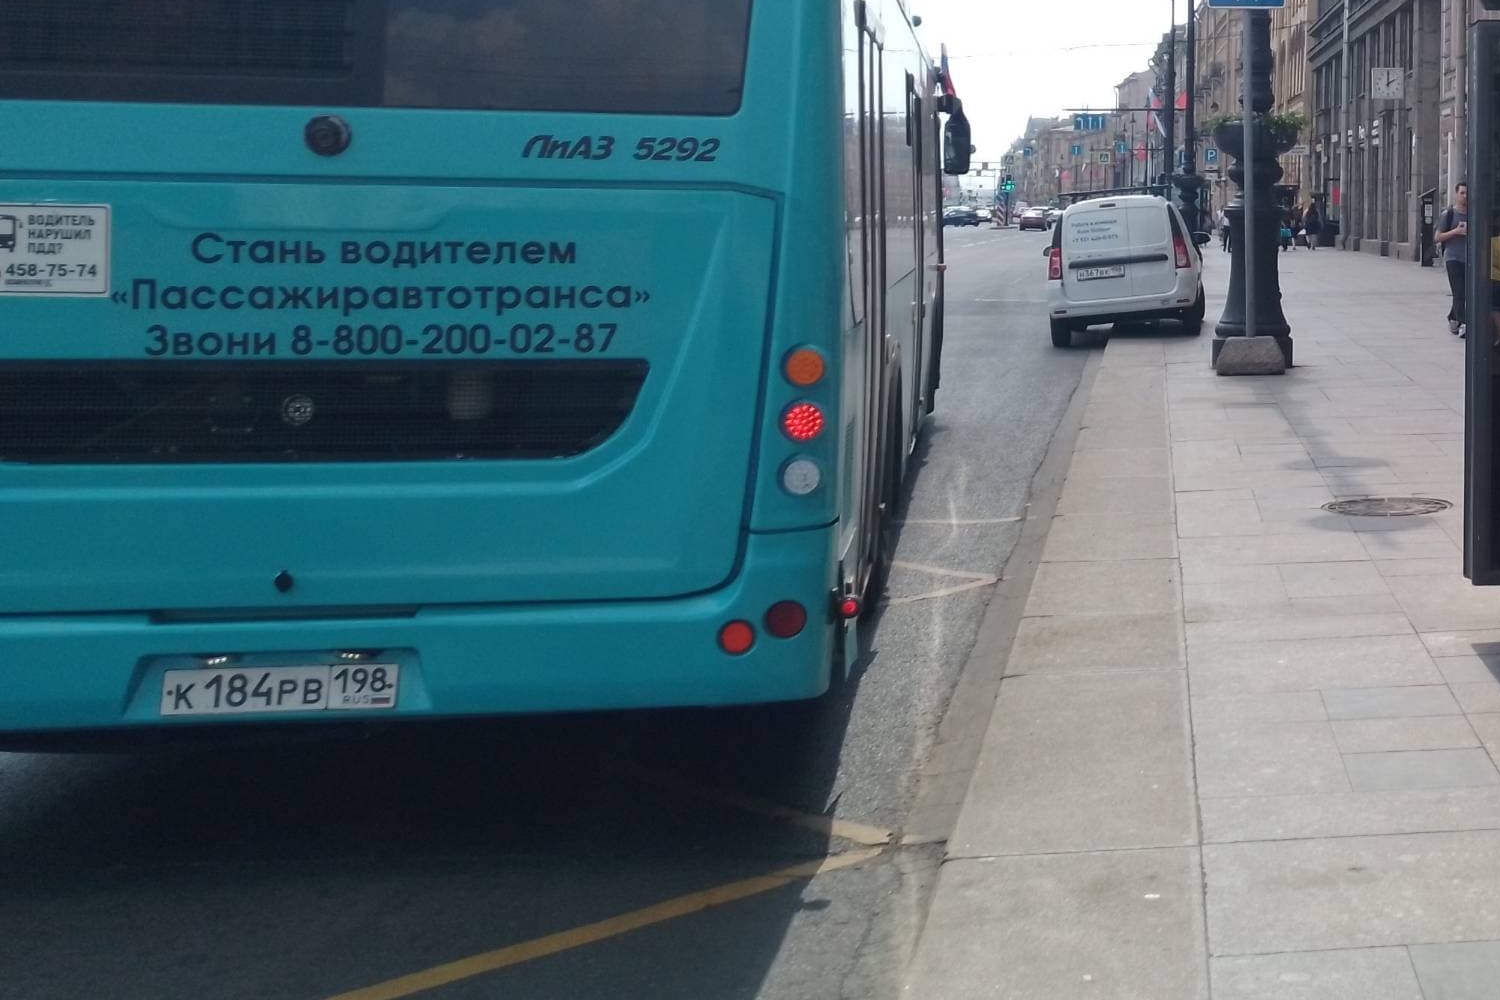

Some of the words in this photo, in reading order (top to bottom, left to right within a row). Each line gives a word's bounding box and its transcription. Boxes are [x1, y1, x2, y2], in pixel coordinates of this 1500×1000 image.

[632, 136, 721, 162] 5292
[28, 214, 95, 226] ВОДИТЕЛЬ
[28, 229, 92, 240] НАРУШИЛ
[28, 242, 63, 255] ПДД?
[191, 232, 326, 264] Стань
[340, 240, 577, 268] водителем
[5, 263, 97, 278] 458-75-74
[110, 278, 650, 317] «Пассажиравтотранса»
[144, 324, 277, 356] Звони
[290, 322, 618, 355] 8-800-200-02-87
[333, 667, 387, 694] 198
[342, 695, 370, 704] RUS
